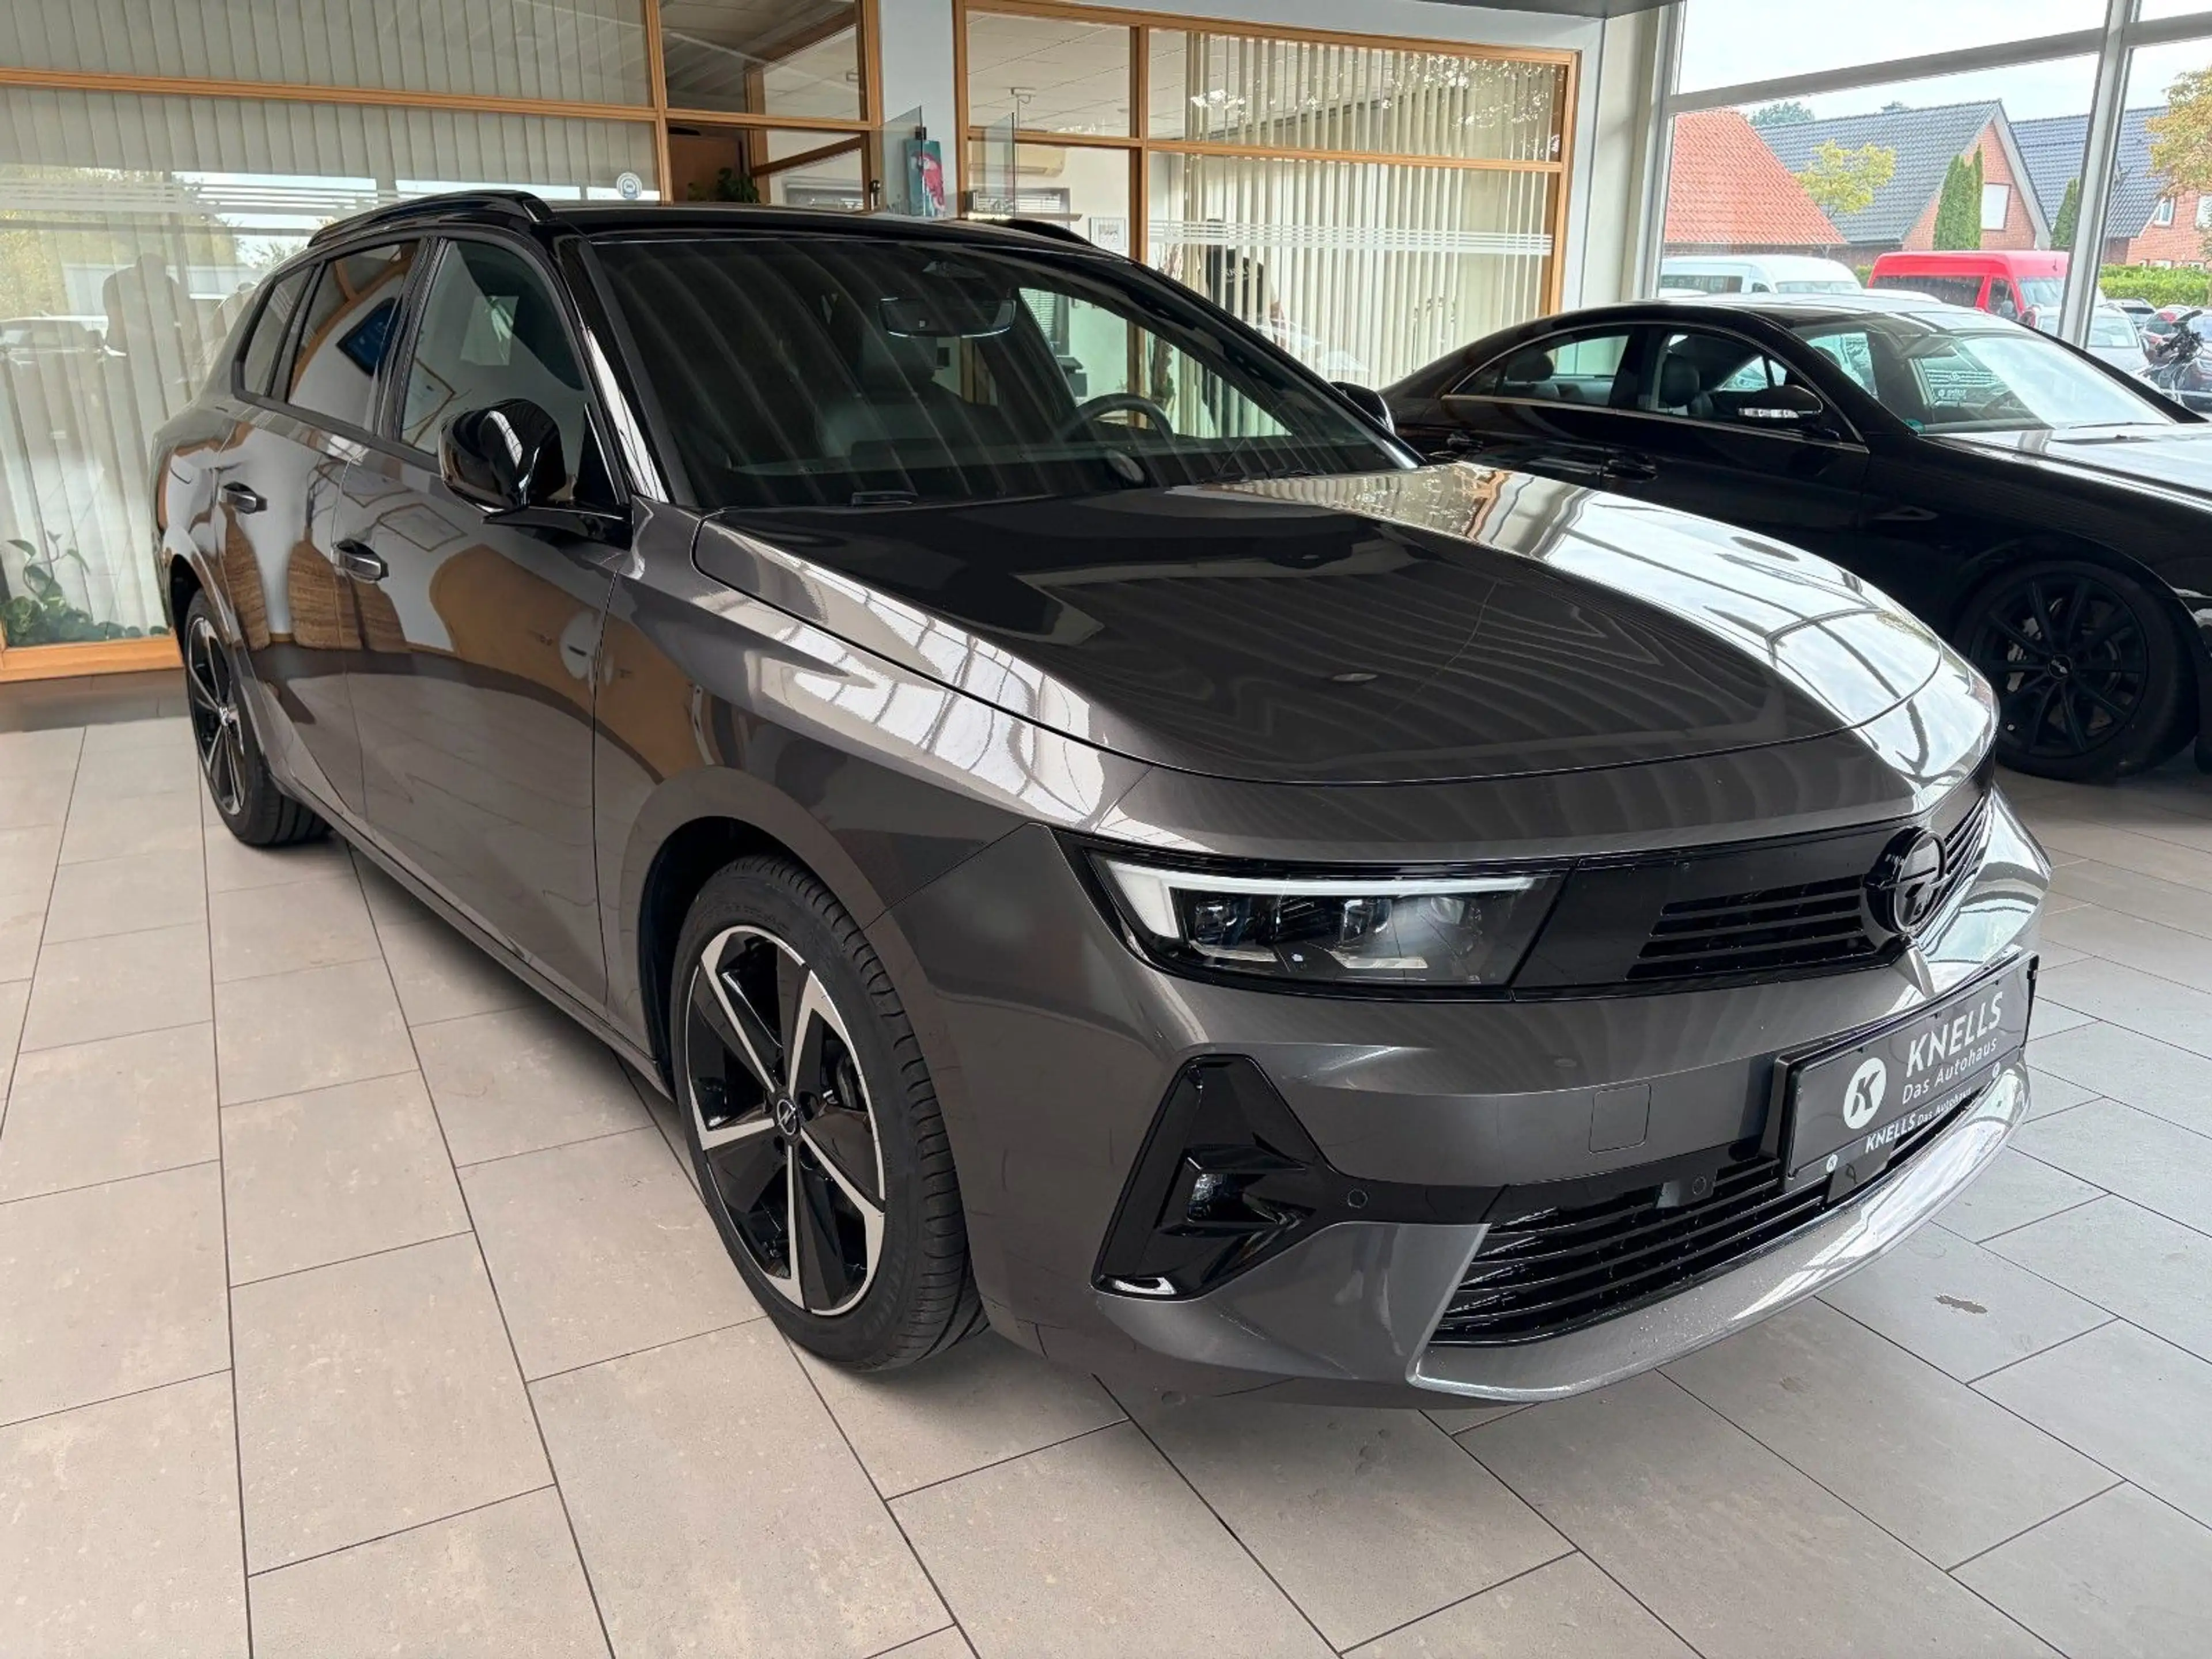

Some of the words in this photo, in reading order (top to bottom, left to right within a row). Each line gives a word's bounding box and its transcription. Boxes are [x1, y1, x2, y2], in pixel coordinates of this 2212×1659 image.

[1906, 991, 2002, 1078] KNELLS
[1903, 1078, 1929, 1104] Das
[1934, 1038, 1997, 1088] Autohaus
[1865, 1113, 1916, 1154] KNELLS
[1918, 1111, 1932, 1125] Das
